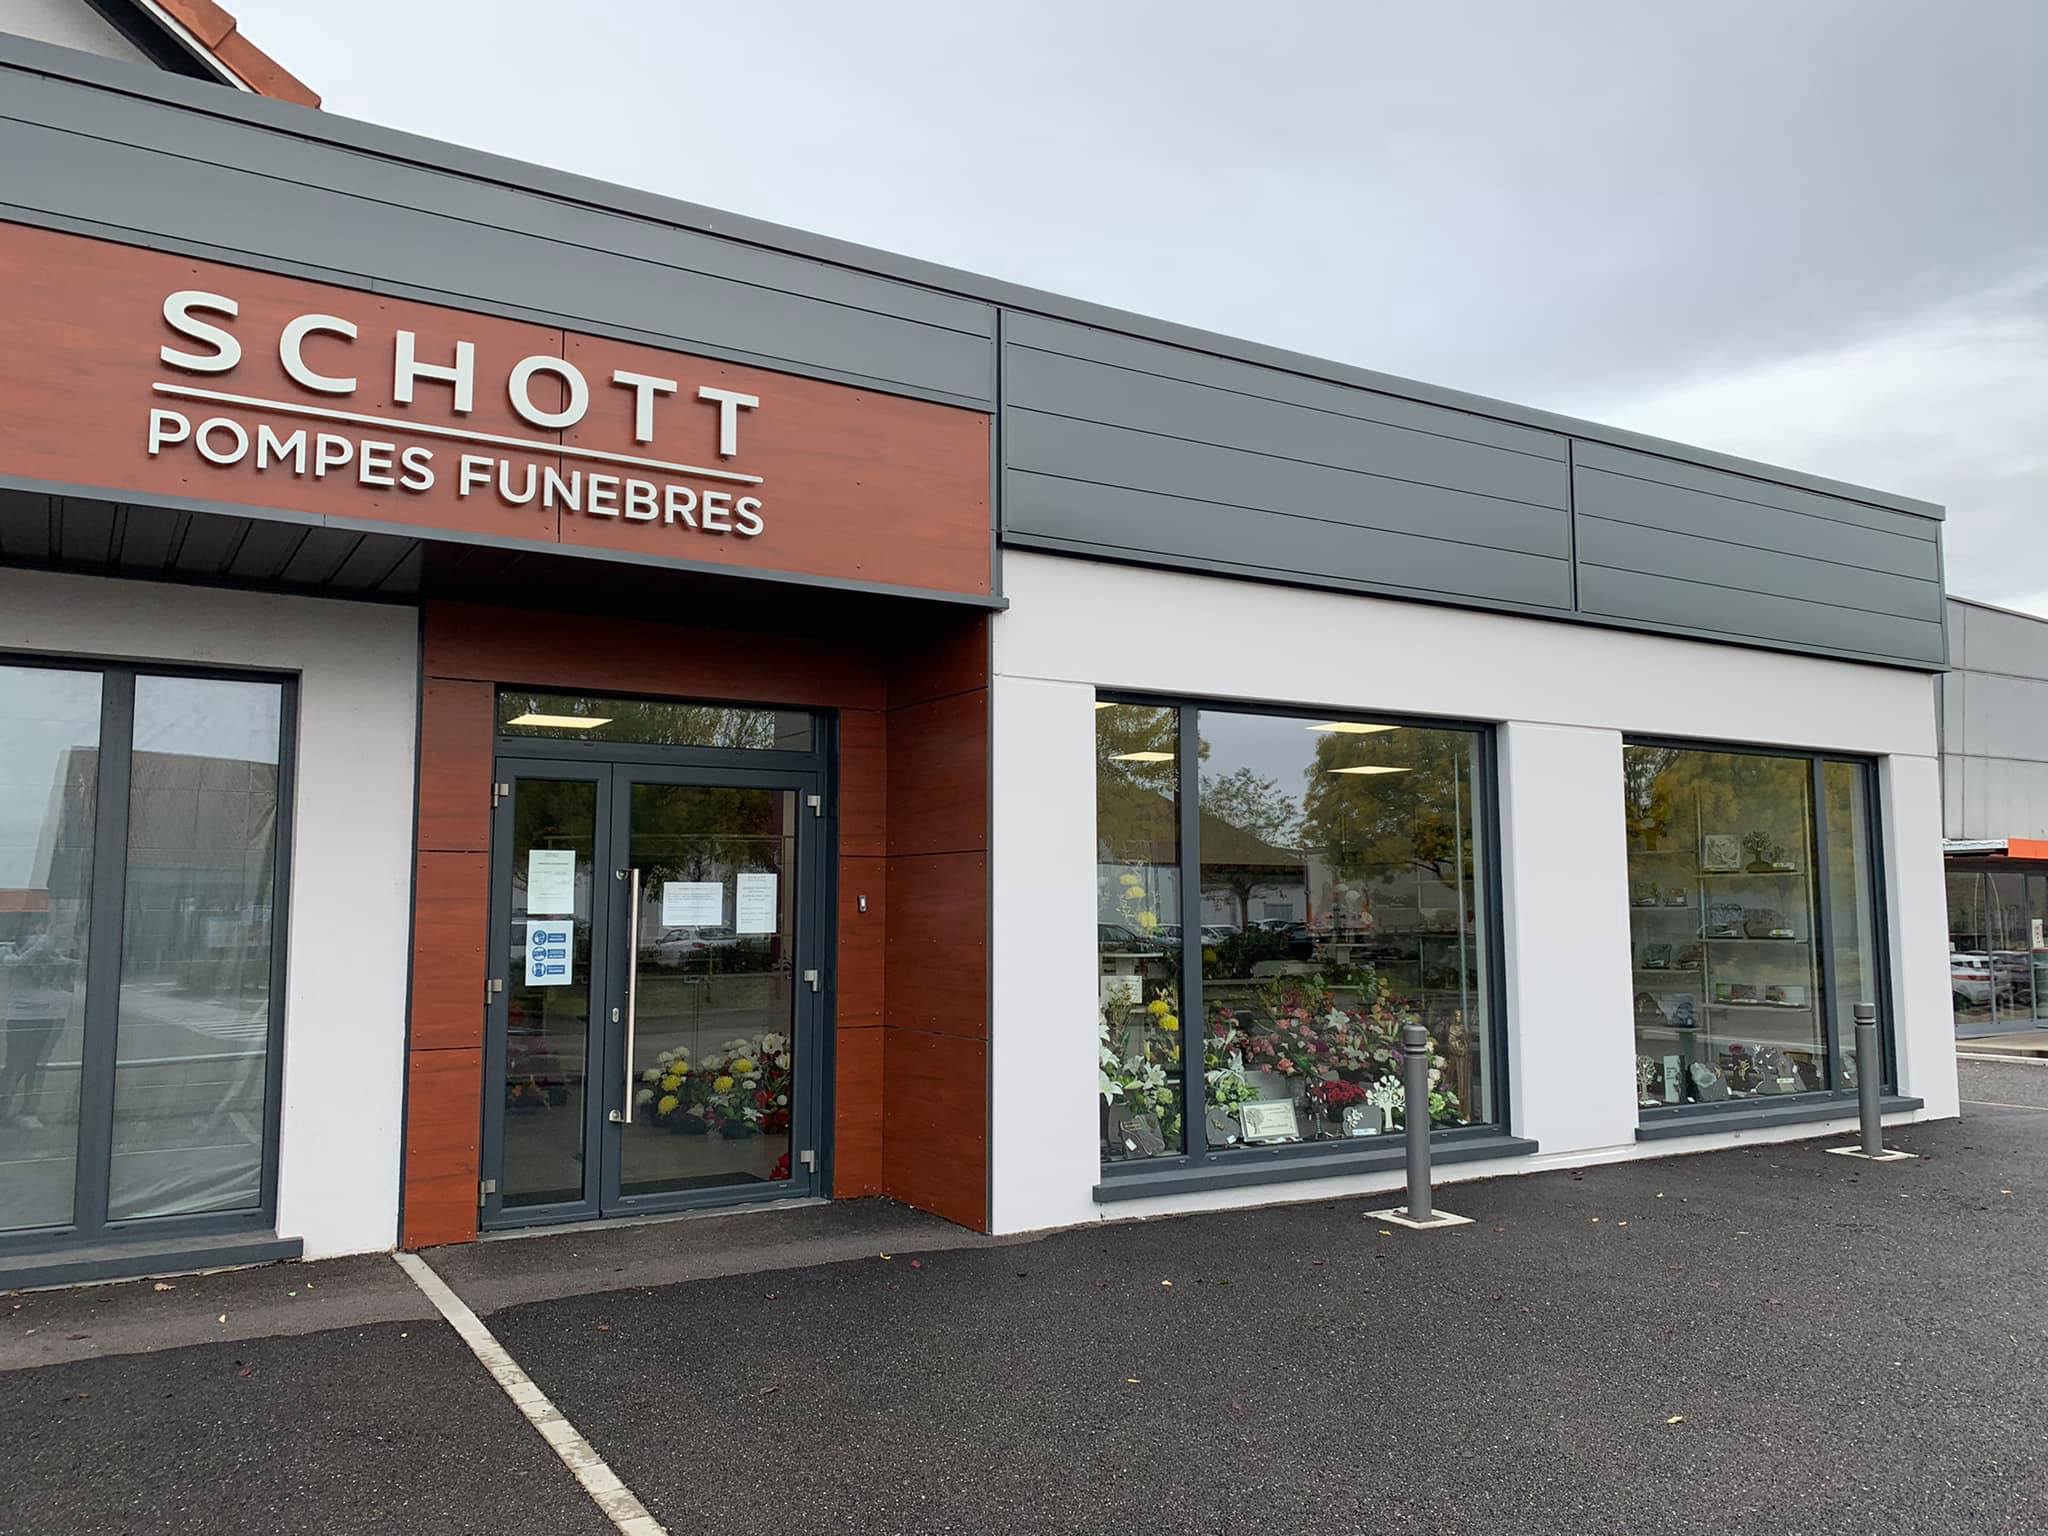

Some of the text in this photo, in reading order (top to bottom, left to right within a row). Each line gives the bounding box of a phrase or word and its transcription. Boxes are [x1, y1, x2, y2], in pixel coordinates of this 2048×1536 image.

[160, 290, 760, 456] SCHOTT
[148, 408, 764, 536] POMPES FUNEBRES
